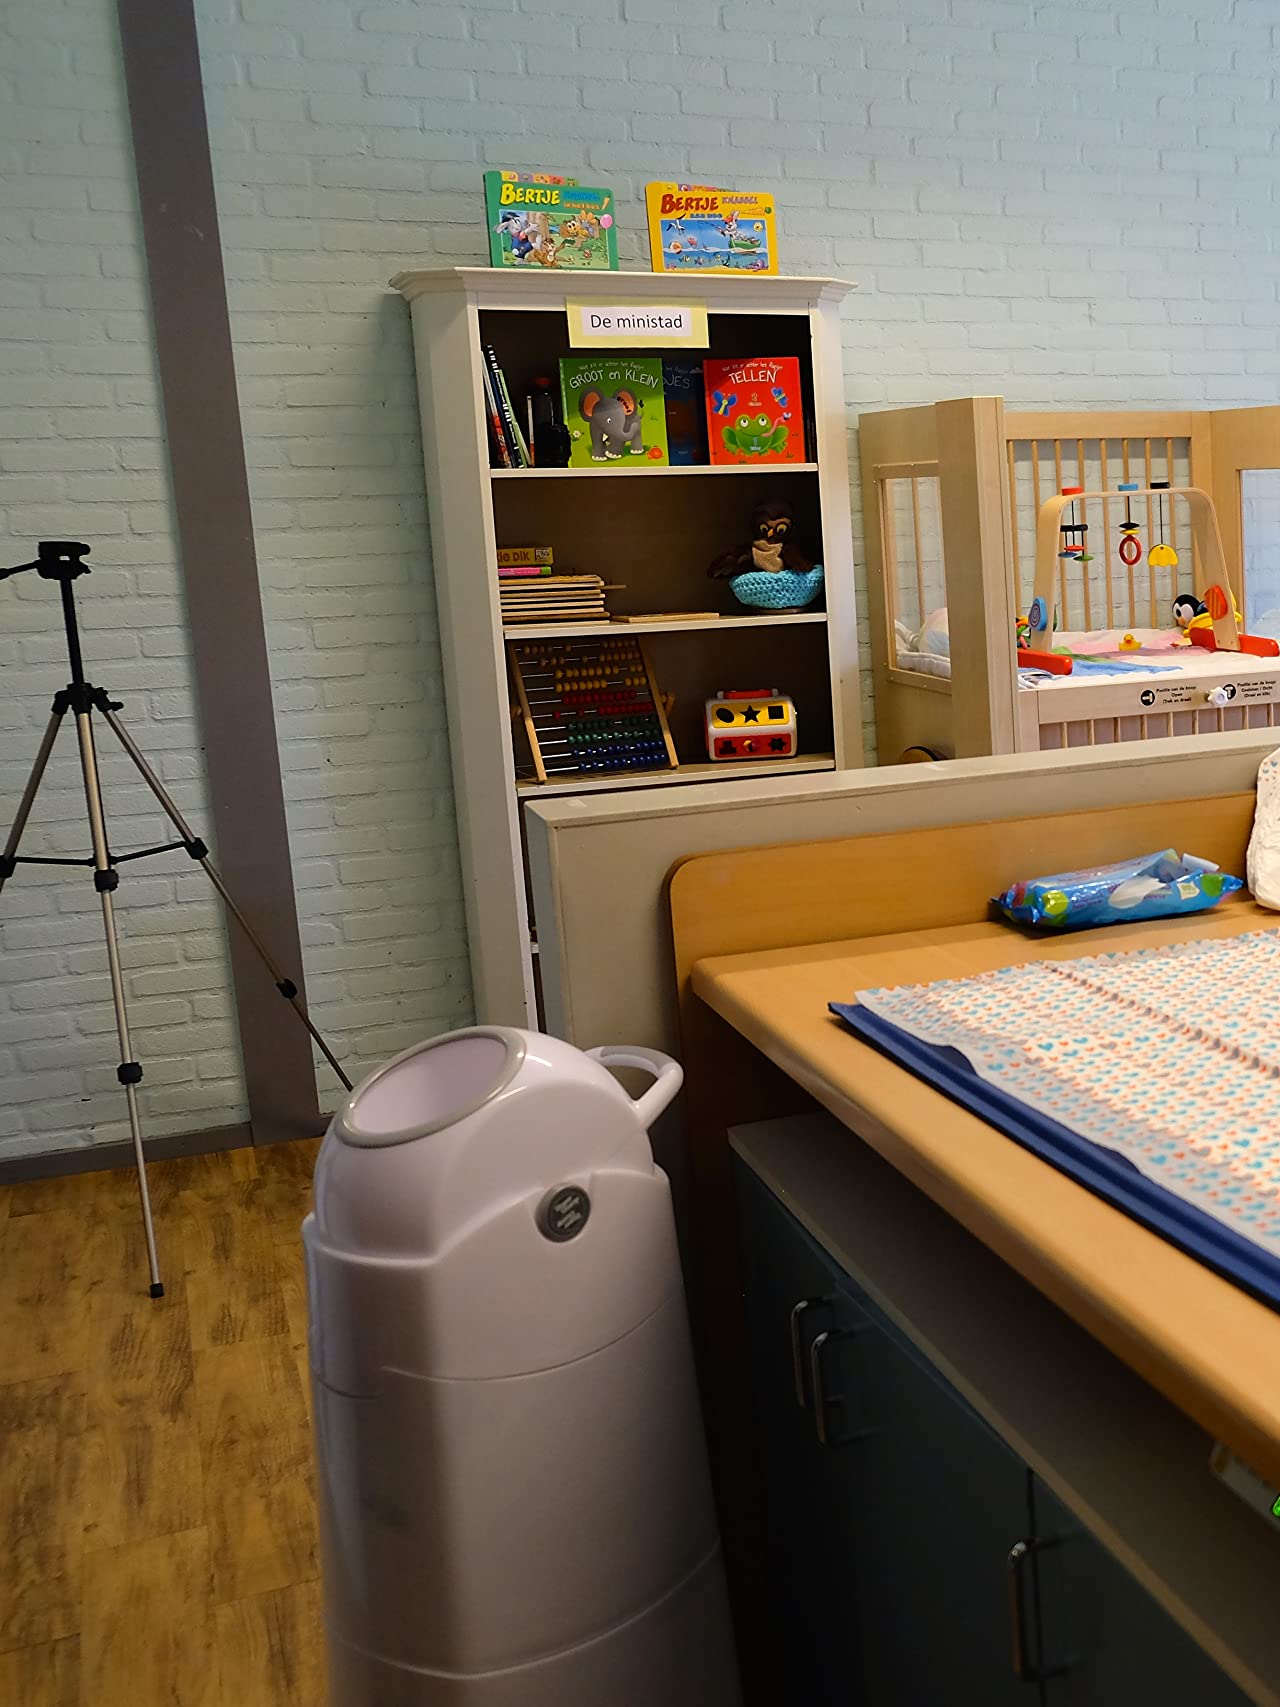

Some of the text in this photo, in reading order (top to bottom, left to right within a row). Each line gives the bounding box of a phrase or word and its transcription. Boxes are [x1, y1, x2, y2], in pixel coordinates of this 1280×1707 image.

[500, 183, 560, 205] BERTJE
[660, 193, 719, 214] BERTJE
[590, 314, 683, 329] De ministad
[569, 369, 659, 389] GROOT en KLEIN
[728, 369, 778, 384] TELLEN
